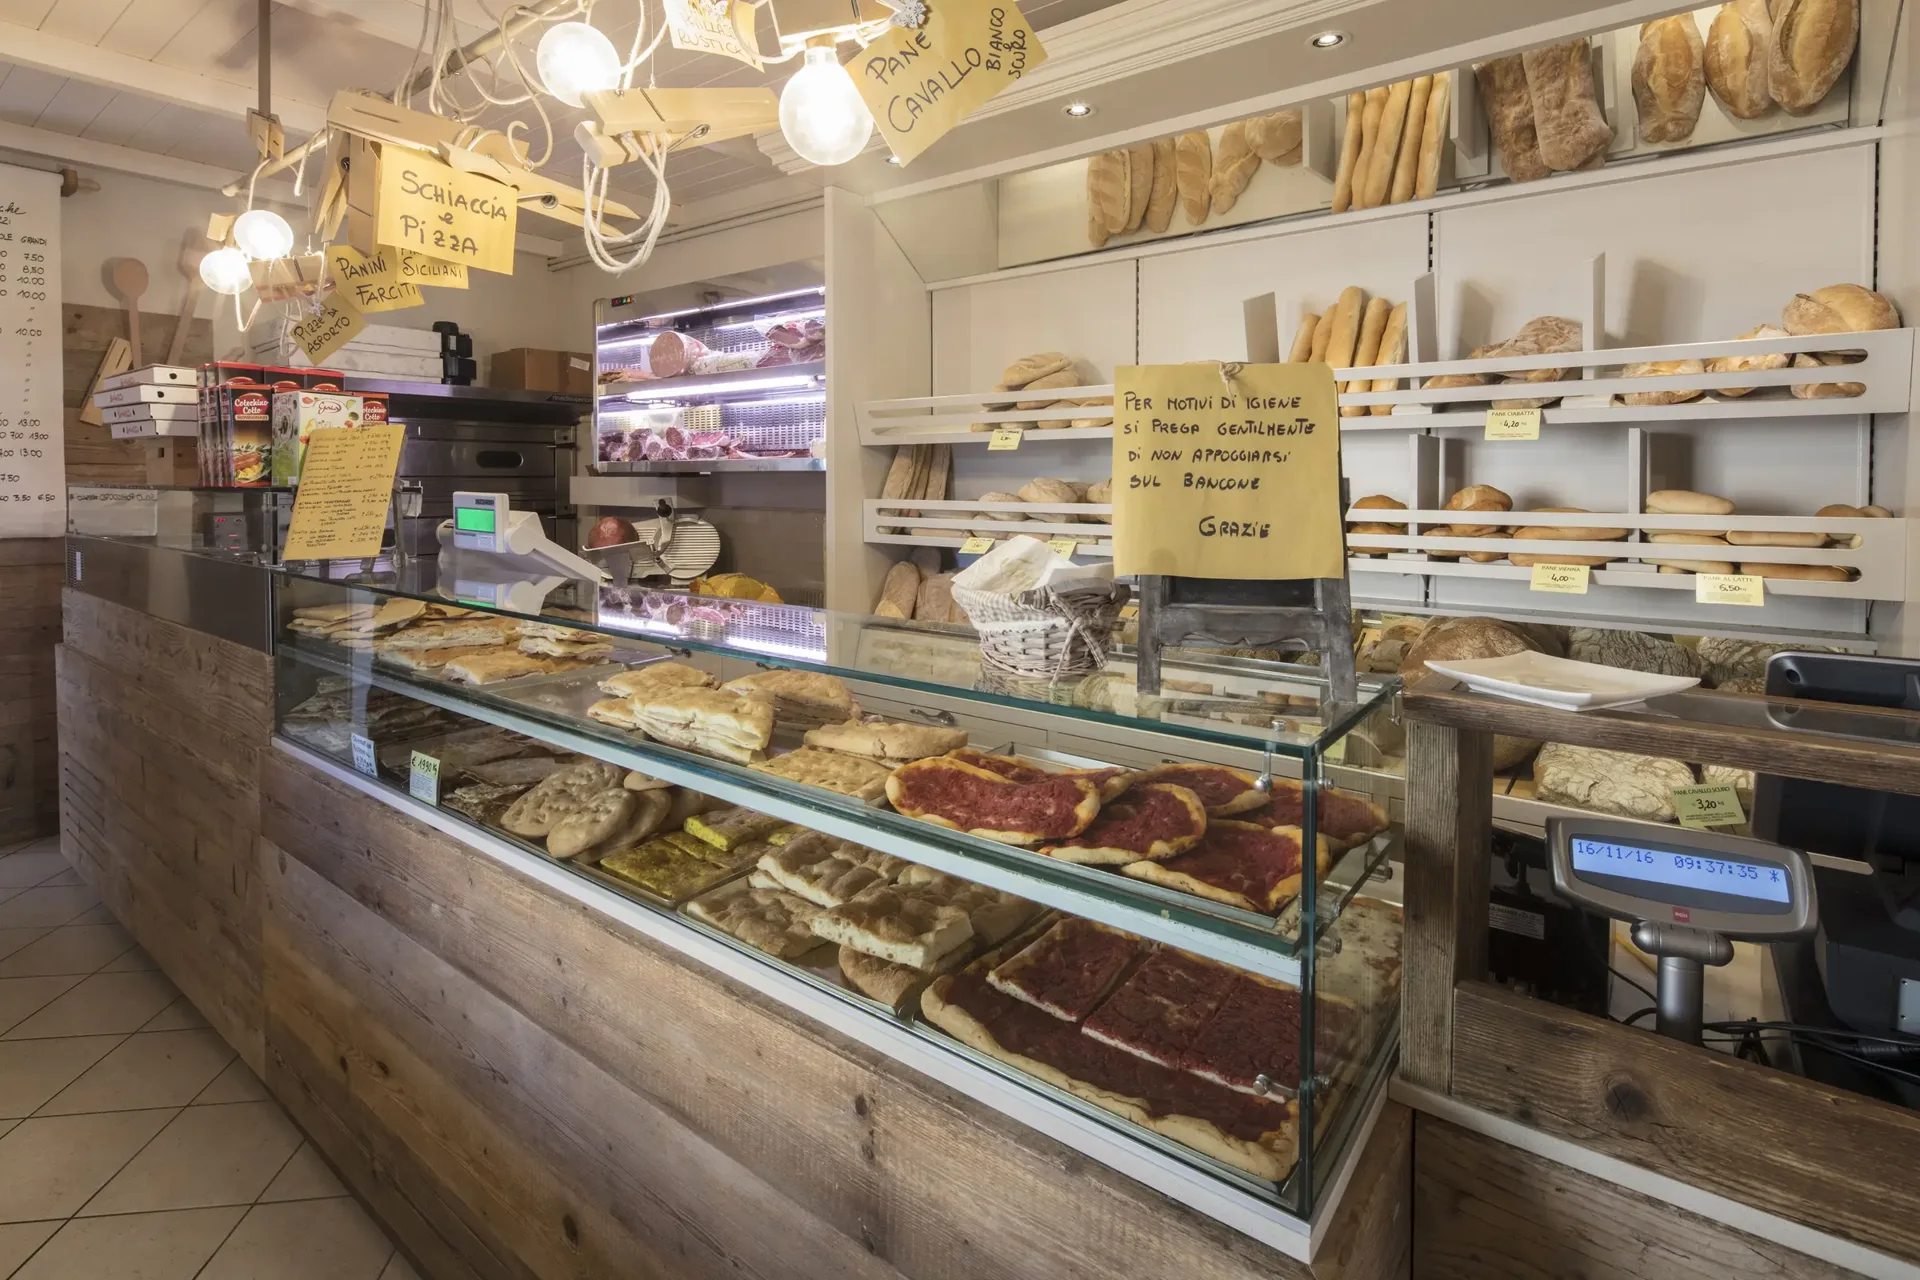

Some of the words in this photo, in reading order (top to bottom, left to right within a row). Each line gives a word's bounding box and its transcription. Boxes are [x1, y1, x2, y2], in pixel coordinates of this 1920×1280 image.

[986, 7, 1005, 71] BIANCO
[866, 32, 931, 84] PANE
[1008, 29, 1026, 79] SCURO
[888, 48, 981, 133] CAVALLO
[401, 170, 507, 221] SCHIACCIA
[20, 236, 47, 245] GRANDI
[400, 214, 478, 256] PIZZA
[336, 251, 387, 280] PANINI
[402, 257, 462, 279] SICILIANI
[356, 281, 417, 305] FARCITI
[15, 328, 42, 336] 10.00
[294, 317, 325, 341] PIZZE
[307, 316, 350, 355] ASPORTO
[234, 398, 269, 407] Cotechino
[242, 406, 262, 414] Cotto
[362, 405, 387, 414] otechino
[1124, 391, 1153, 411] PER
[1167, 396, 1213, 411] MOTIVI
[1221, 395, 1236, 409] DI
[1246, 396, 1302, 410] IGIENE
[364, 413, 381, 421] Cotto
[1503, 419, 1520, 429] 4,20
[1124, 420, 1139, 434] SI
[1152, 418, 1200, 434] PREGA
[1217, 418, 1316, 436] GENTILMENTE
[1128, 446, 1141, 462] DI
[1151, 450, 1183, 461] NON
[1192, 448, 1291, 463] APPOGGIARSI
[1130, 474, 1161, 488] SUL
[1184, 472, 1260, 490] BANCONE
[1199, 516, 1271, 538] GRAZIE
[1551, 573, 1569, 582] 4,00
[1719, 583, 1741, 592] 6,50
[1688, 787, 1712, 795] CAVALLO
[1696, 798, 1717, 811] 3,20
[1577, 841, 1654, 864] 16/11/16
[1674, 855, 1759, 880] 09:37:35
